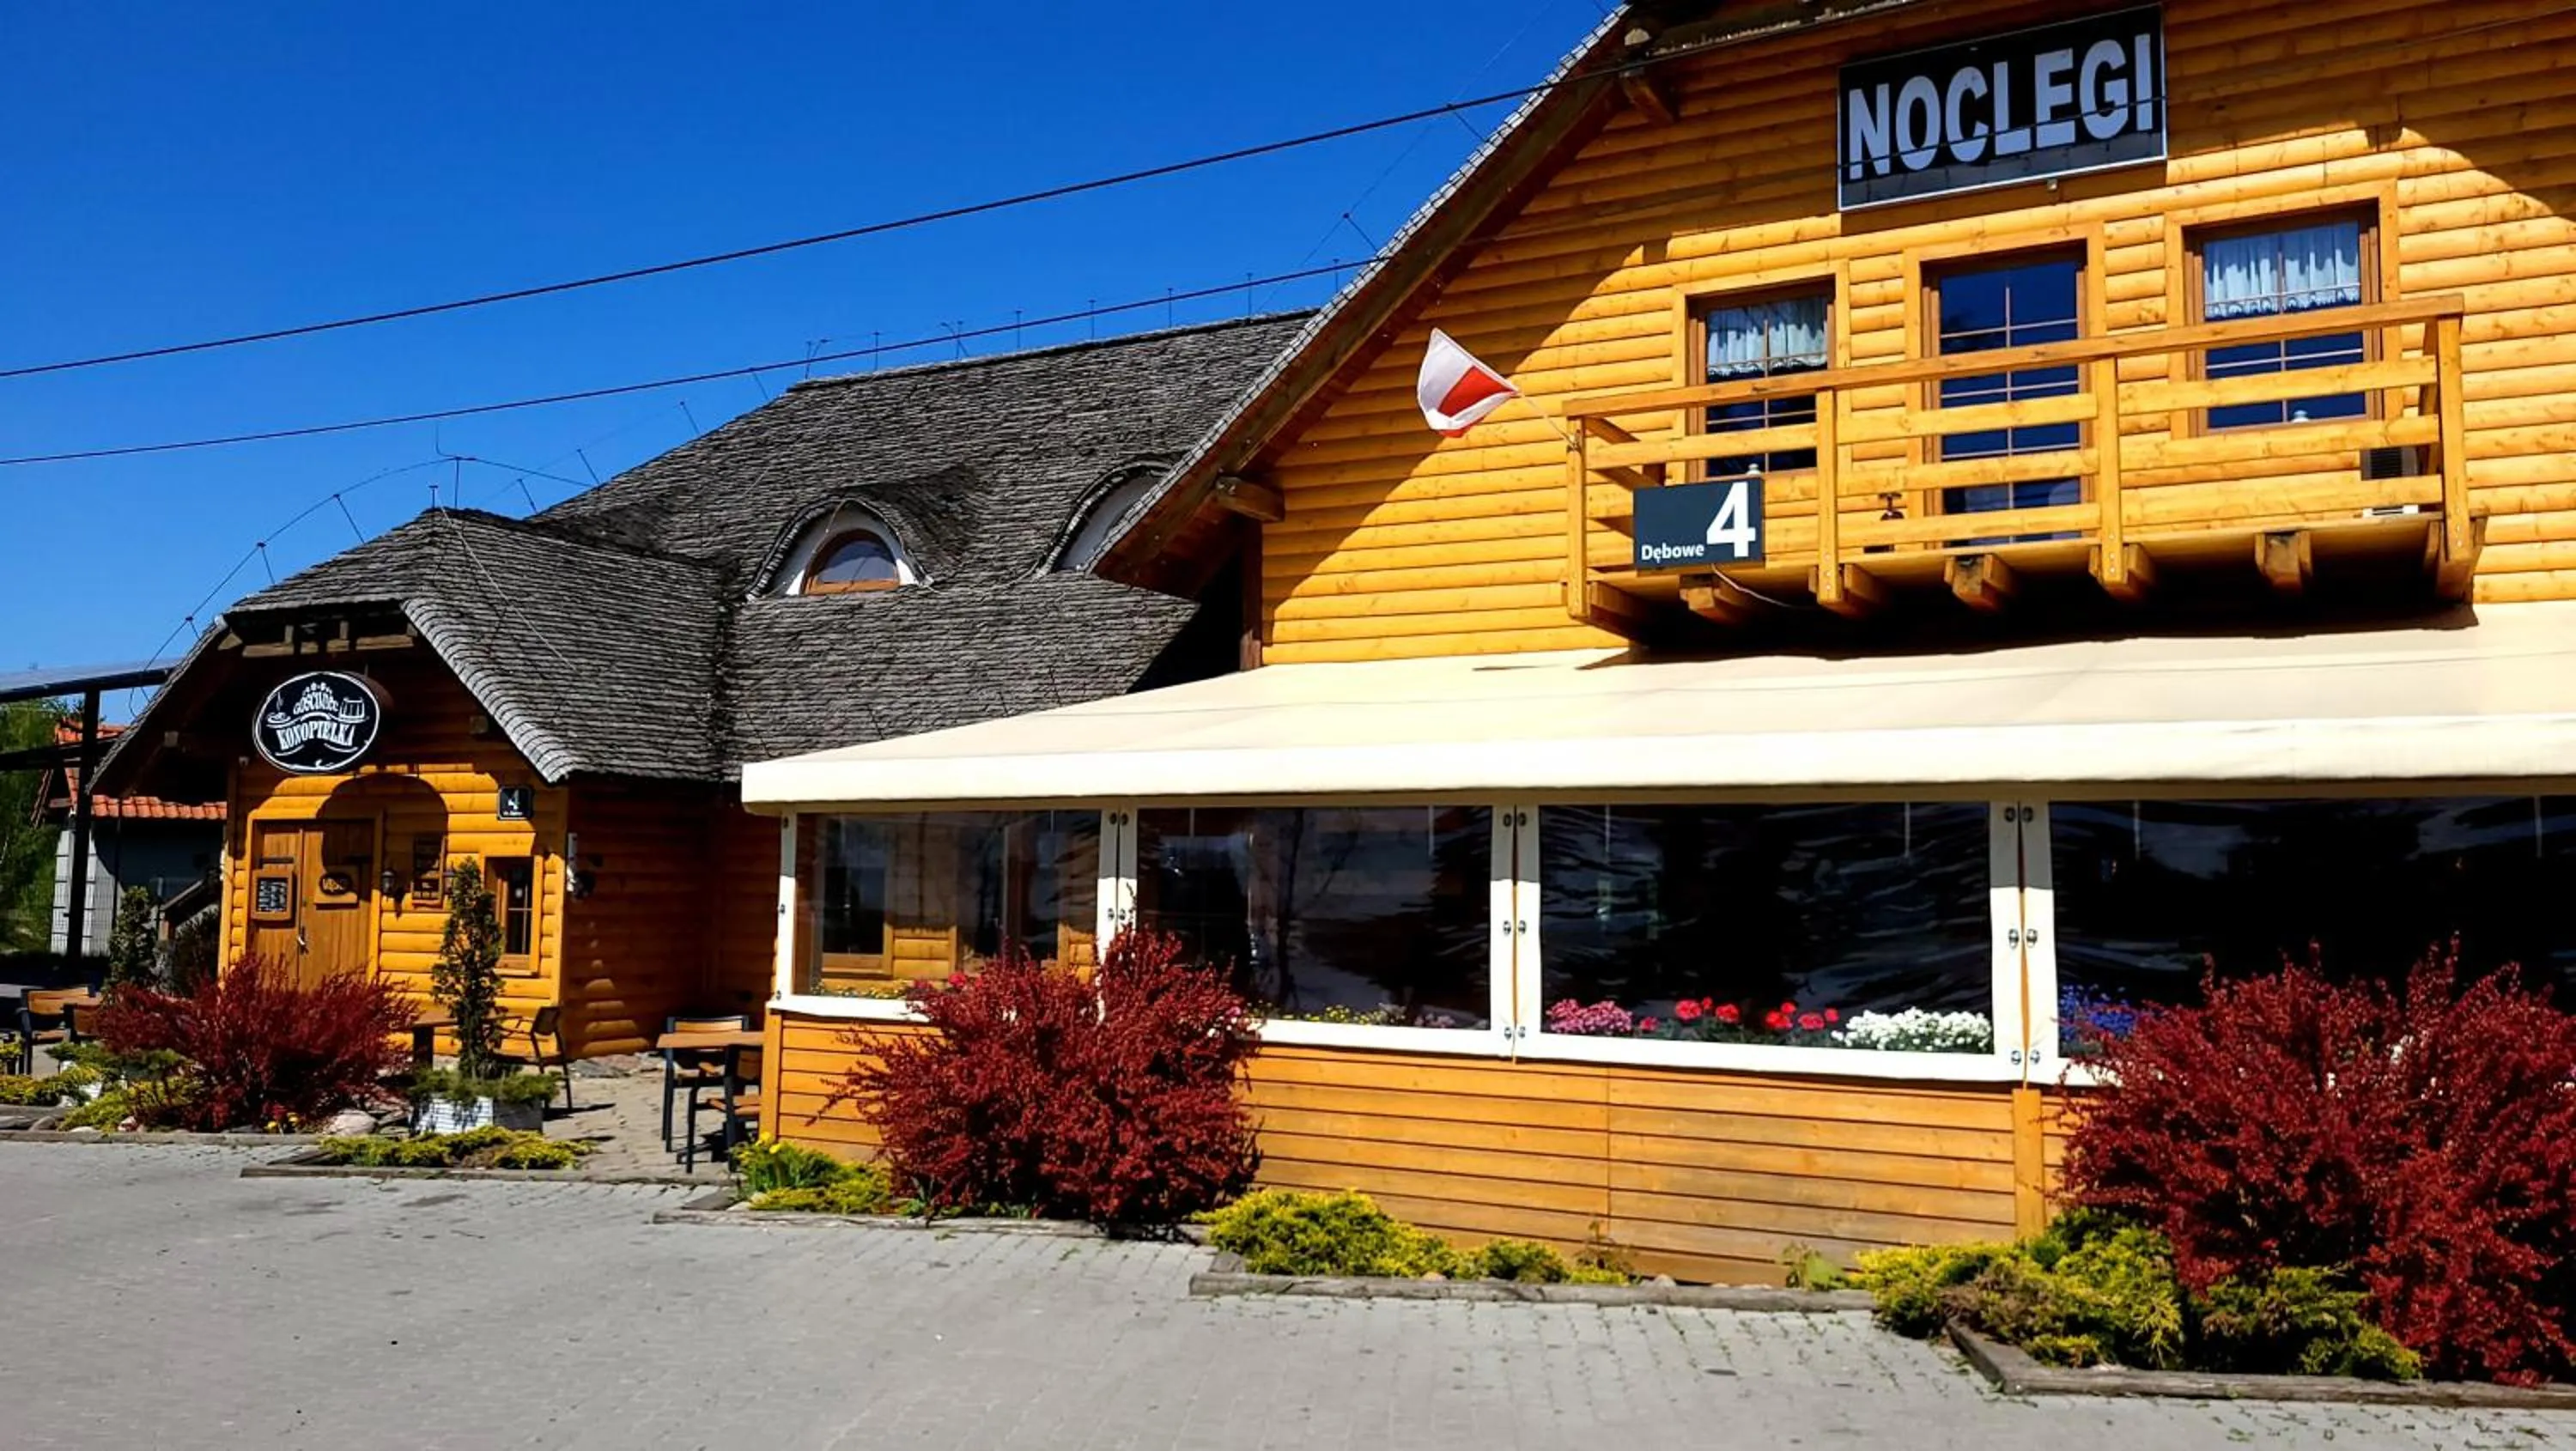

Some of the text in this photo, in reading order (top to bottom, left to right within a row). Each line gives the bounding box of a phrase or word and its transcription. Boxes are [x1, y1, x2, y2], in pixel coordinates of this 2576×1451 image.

[1849, 33, 2154, 180] NOCLEGI
[1641, 481, 1756, 563] Dębowe 4
[276, 720, 356, 751] KONOPIELKA
